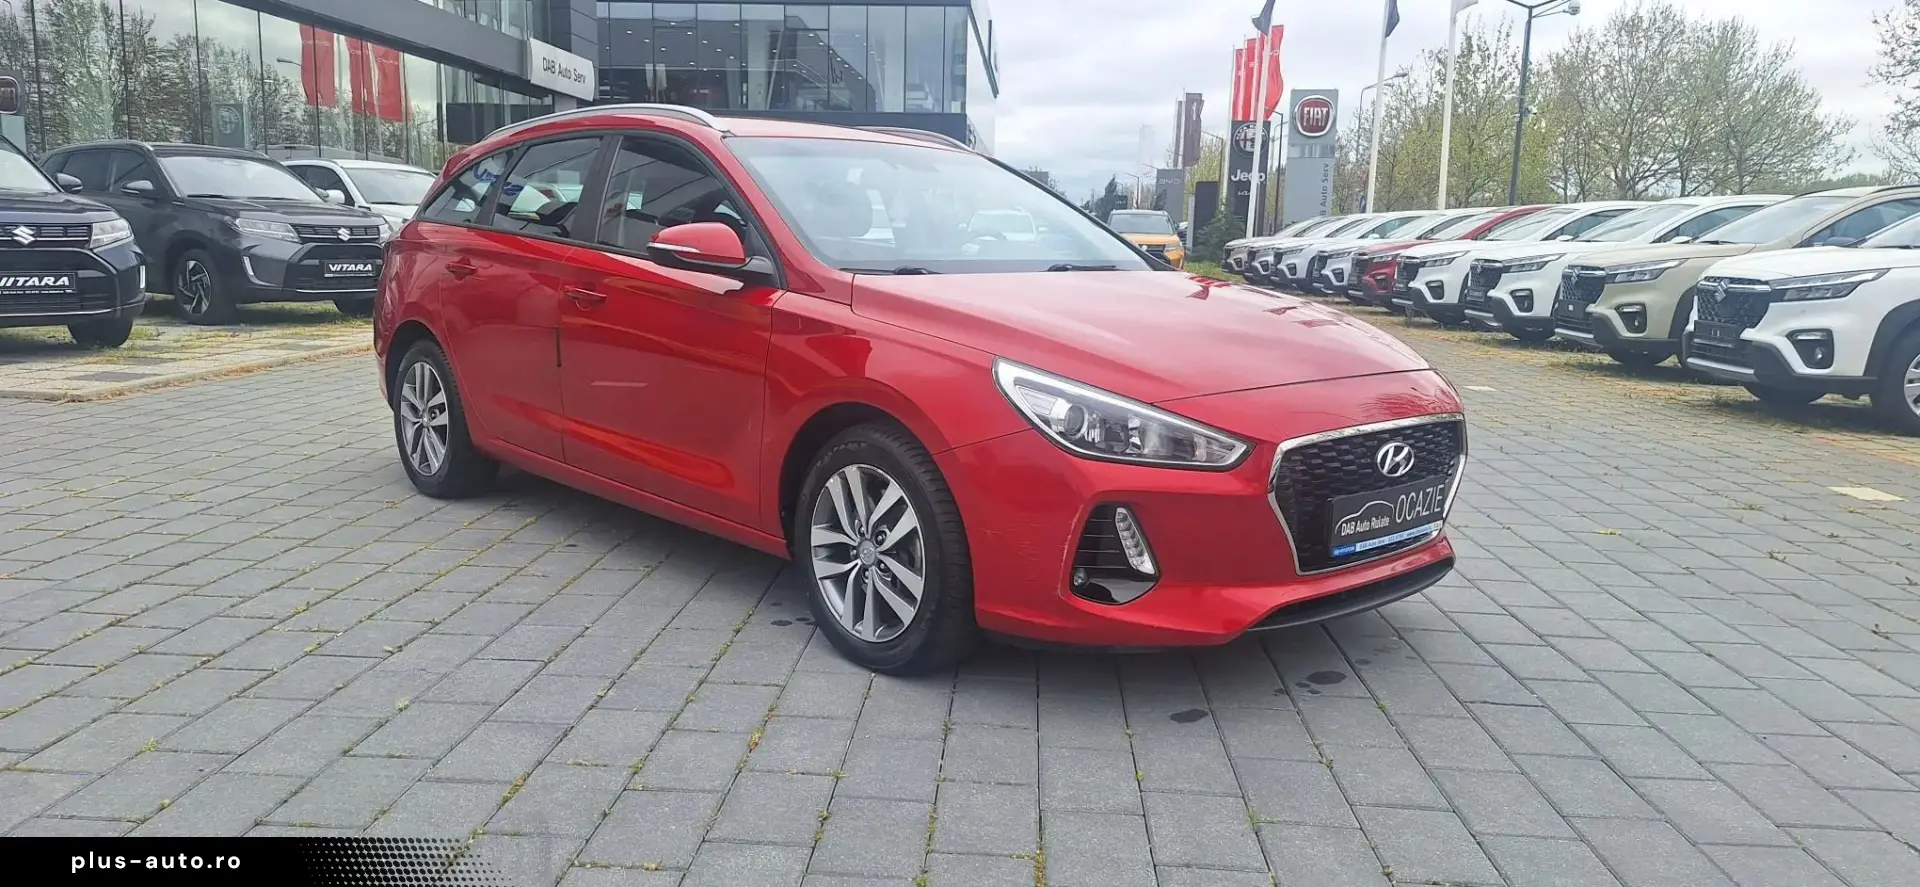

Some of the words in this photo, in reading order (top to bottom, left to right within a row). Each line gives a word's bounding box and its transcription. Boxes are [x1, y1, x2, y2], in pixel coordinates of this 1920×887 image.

[543, 56, 556, 74] DAB
[558, 62, 571, 80] Auto
[574, 68, 586, 84] Serv
[1303, 107, 1329, 126] FIAT
[1320, 187, 1328, 207] Auto
[328, 263, 373, 271] VITARA
[1395, 484, 1444, 523] OCAZIE
[1341, 521, 1355, 536] DAB
[1355, 520, 1370, 533] Auto
